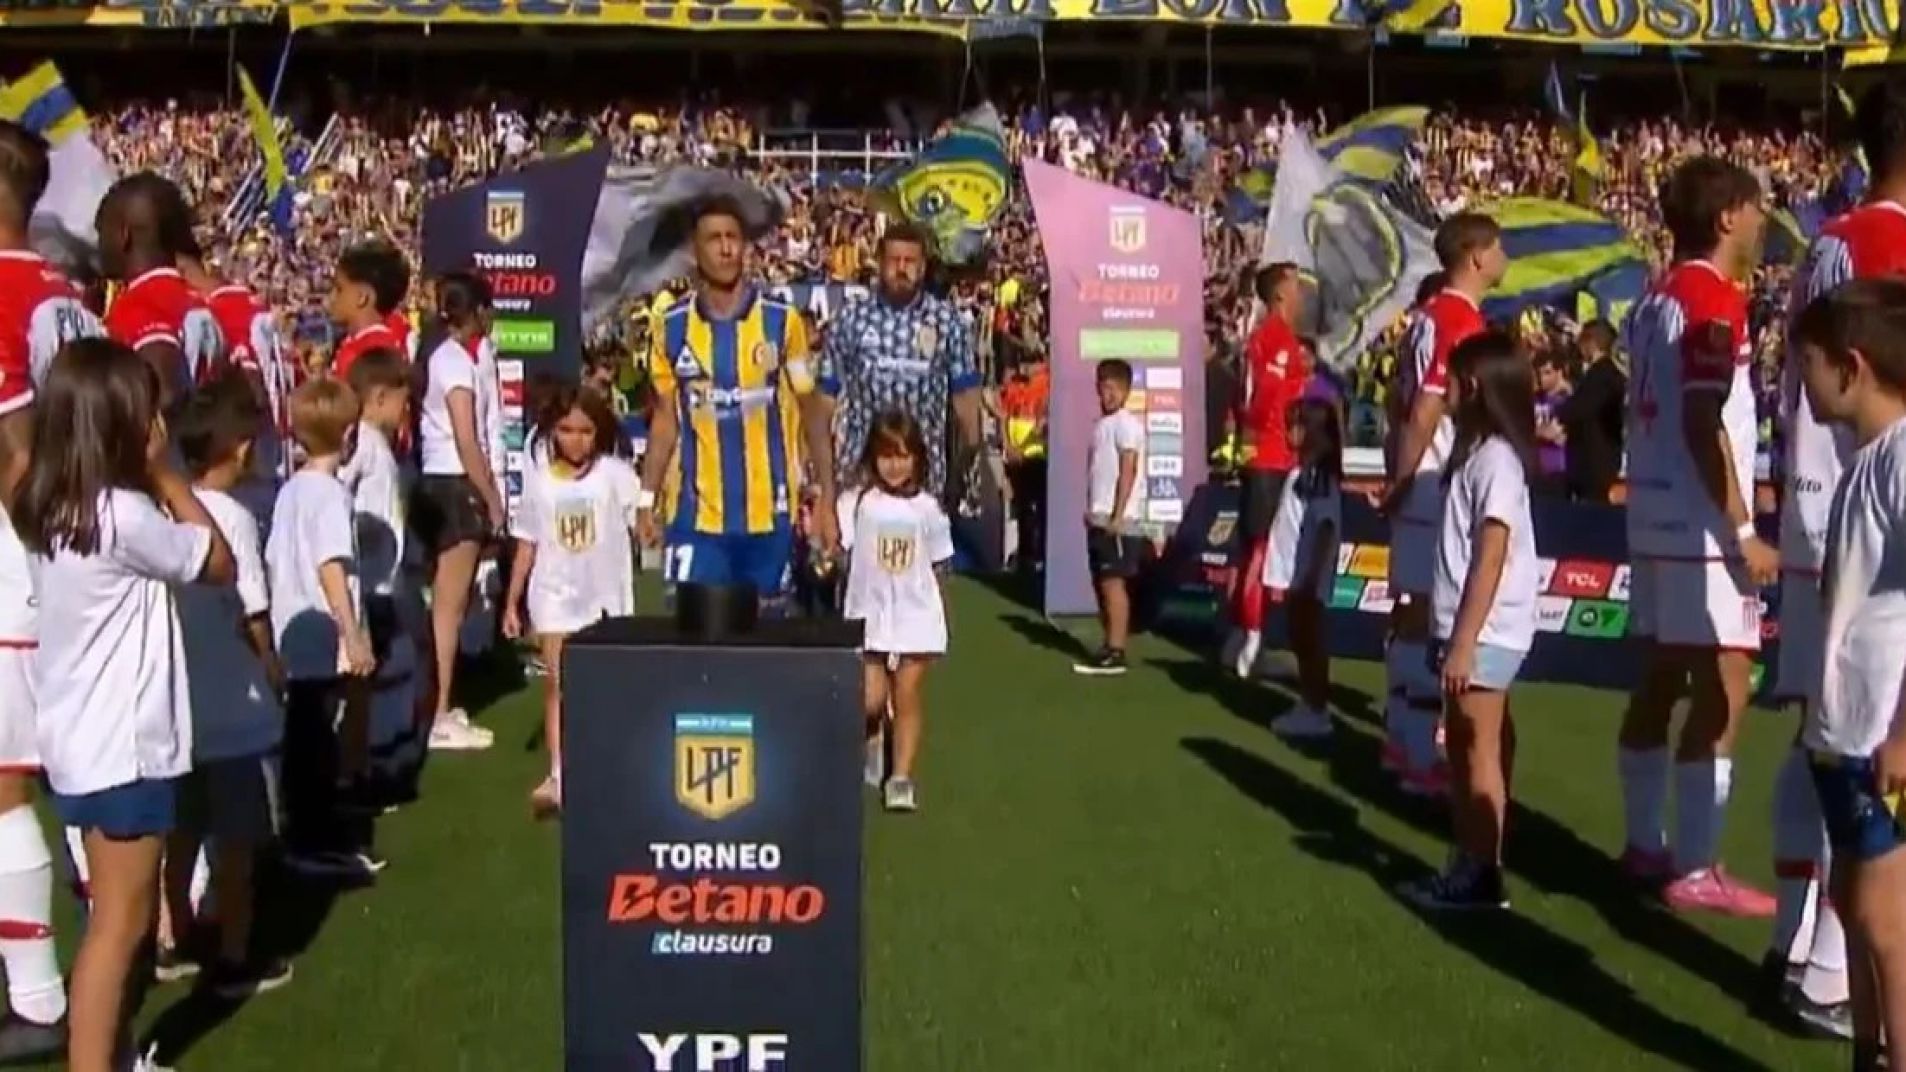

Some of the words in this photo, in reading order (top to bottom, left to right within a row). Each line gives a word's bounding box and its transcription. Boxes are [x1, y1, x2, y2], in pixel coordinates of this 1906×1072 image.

[473, 253, 537, 269] TORNEO
[1098, 263, 1160, 279] TORNEO
[1566, 571, 1600, 589] TCL
[686, 746, 743, 804] LPF
[649, 842, 782, 871] TORNEO
[607, 873, 826, 924] Betano
[656, 928, 773, 955] clausura
[637, 1032, 790, 1072] YPF
